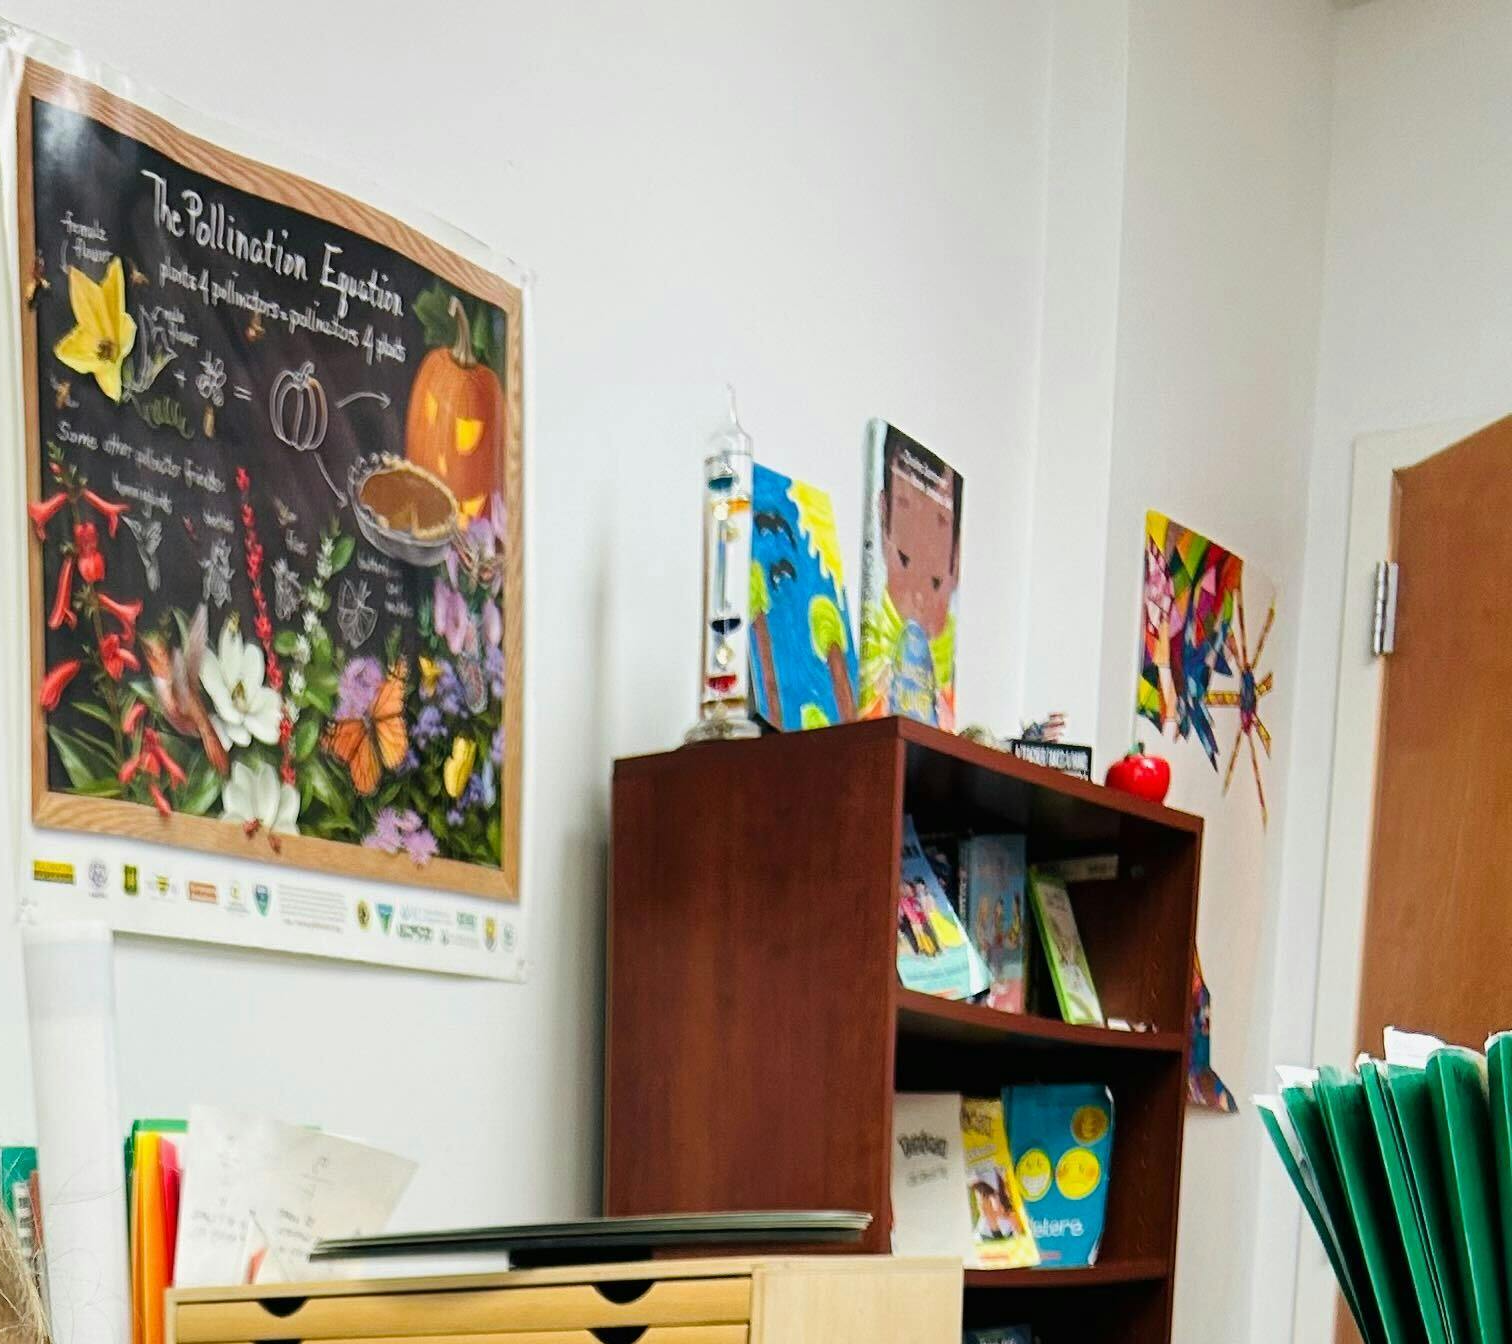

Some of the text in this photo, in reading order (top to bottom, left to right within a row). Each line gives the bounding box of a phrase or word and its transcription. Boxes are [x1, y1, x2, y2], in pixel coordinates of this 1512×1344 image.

[140, 168, 185, 238] The
[181, 189, 309, 281] Pollination
[319, 242, 404, 318] Equation
